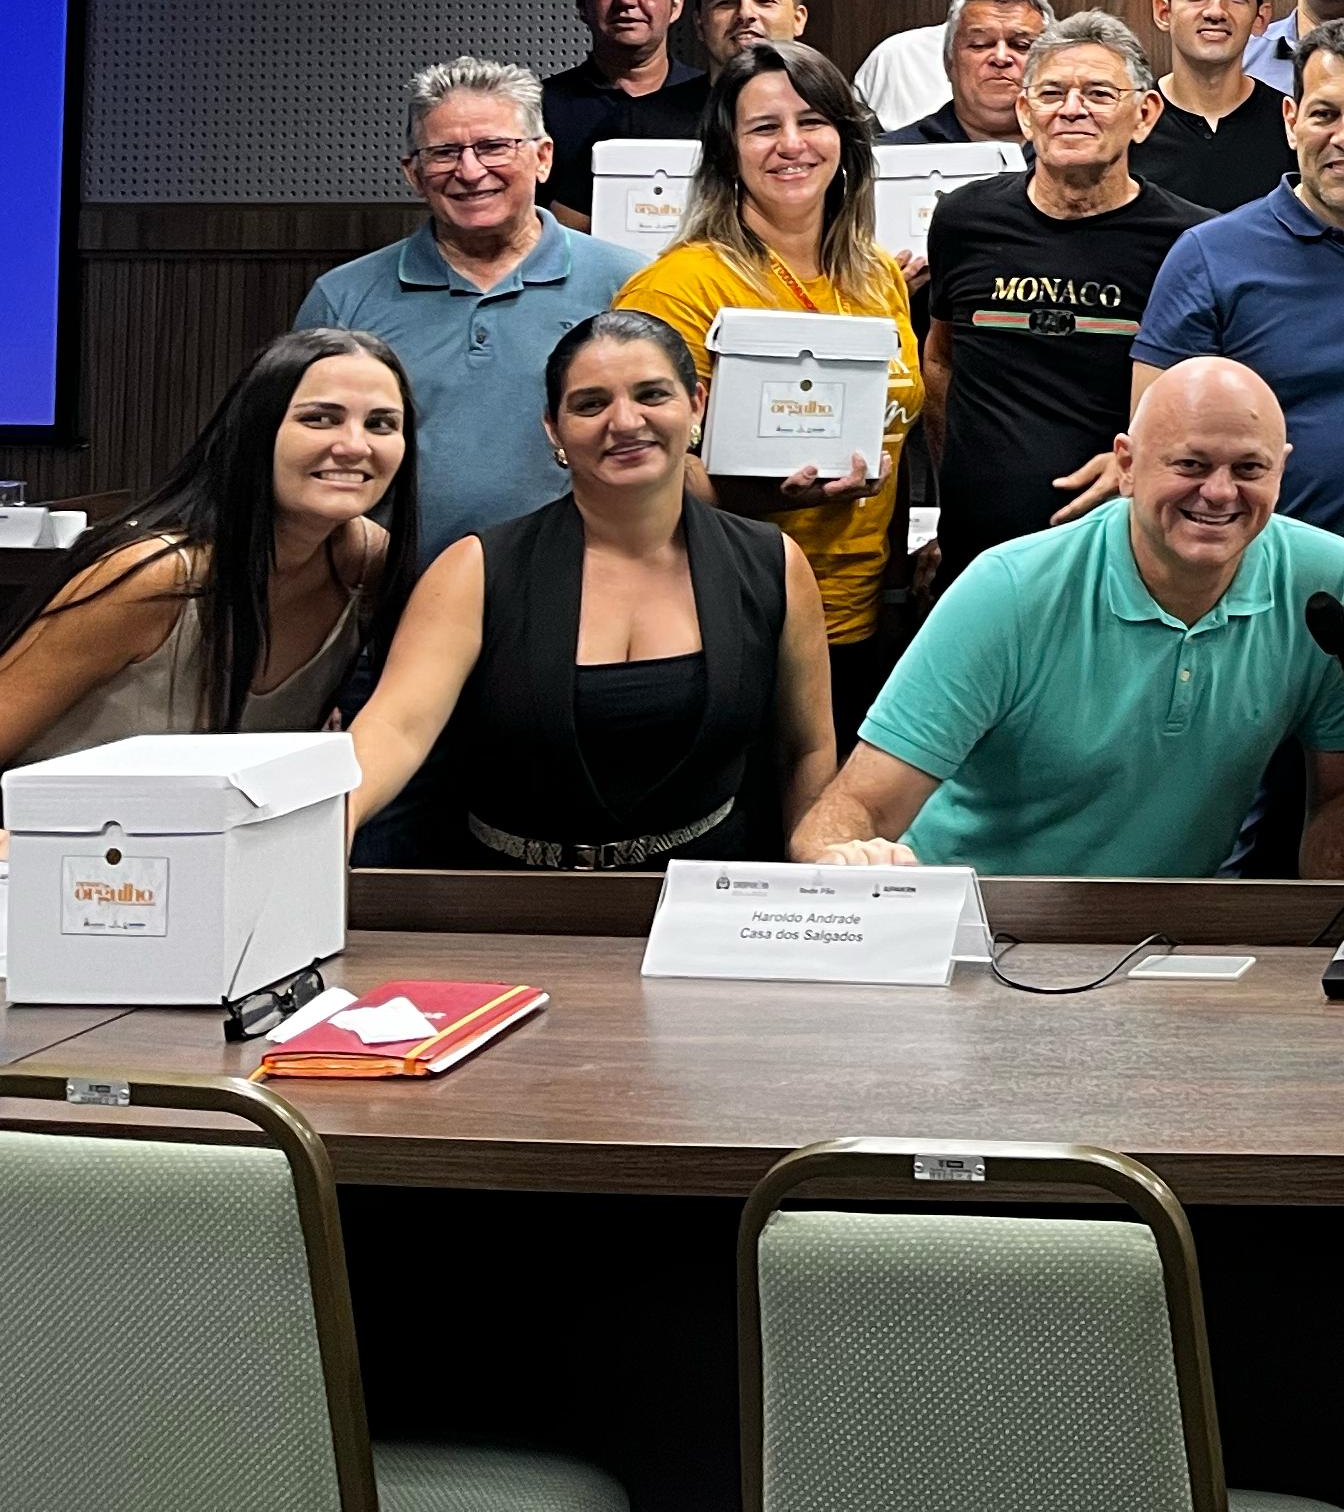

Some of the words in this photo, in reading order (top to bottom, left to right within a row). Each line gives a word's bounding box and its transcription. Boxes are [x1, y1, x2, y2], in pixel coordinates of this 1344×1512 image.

[990, 276, 1122, 308] MONACO
[751, 910, 803, 924] Haroldo
[806, 912, 862, 925] Andrade
[740, 927, 772, 940] Casa
[775, 929, 799, 940] dos
[803, 929, 864, 944] Salgados
